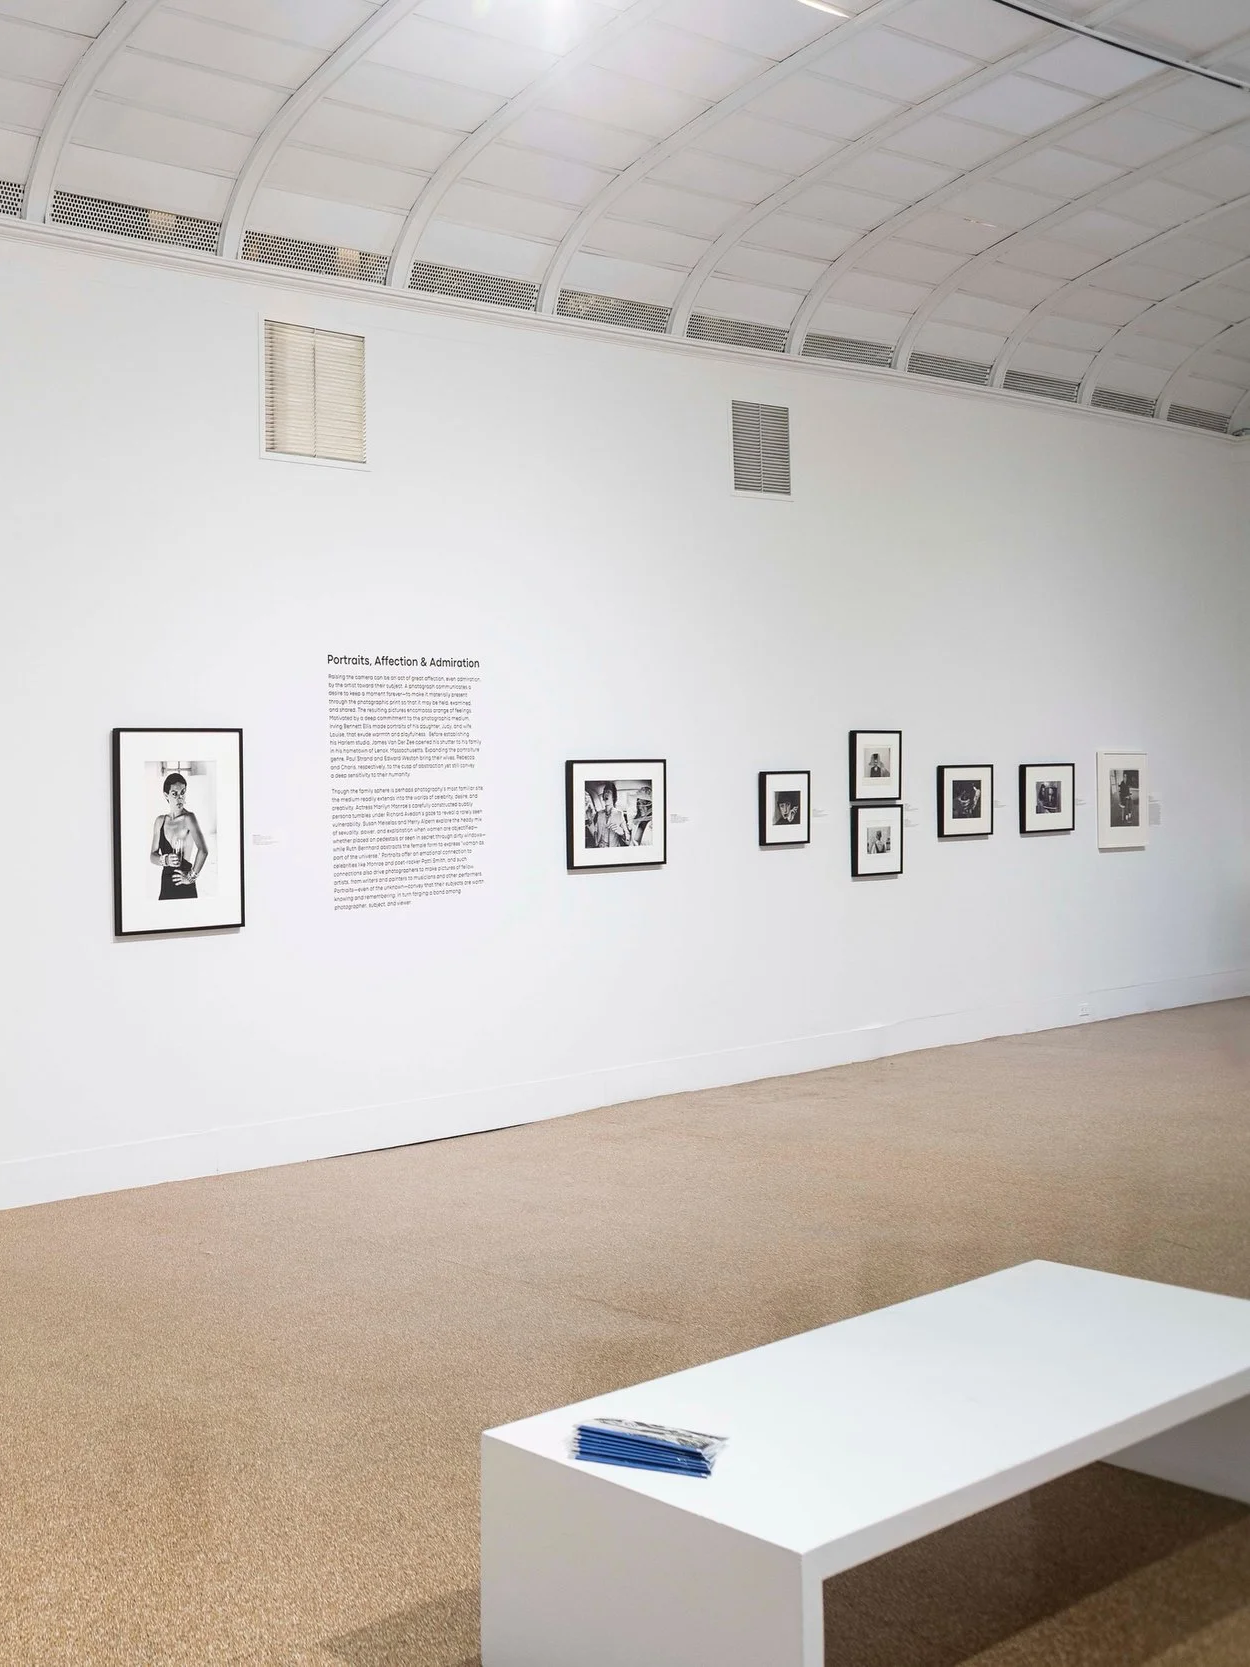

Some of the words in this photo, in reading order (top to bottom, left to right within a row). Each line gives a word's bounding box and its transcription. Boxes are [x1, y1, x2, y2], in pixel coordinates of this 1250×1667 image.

[328, 655, 371, 666] Portraits,
[375, 656, 418, 666] Affection
[421, 657, 427, 666] &
[430, 658, 479, 668] Admiration
